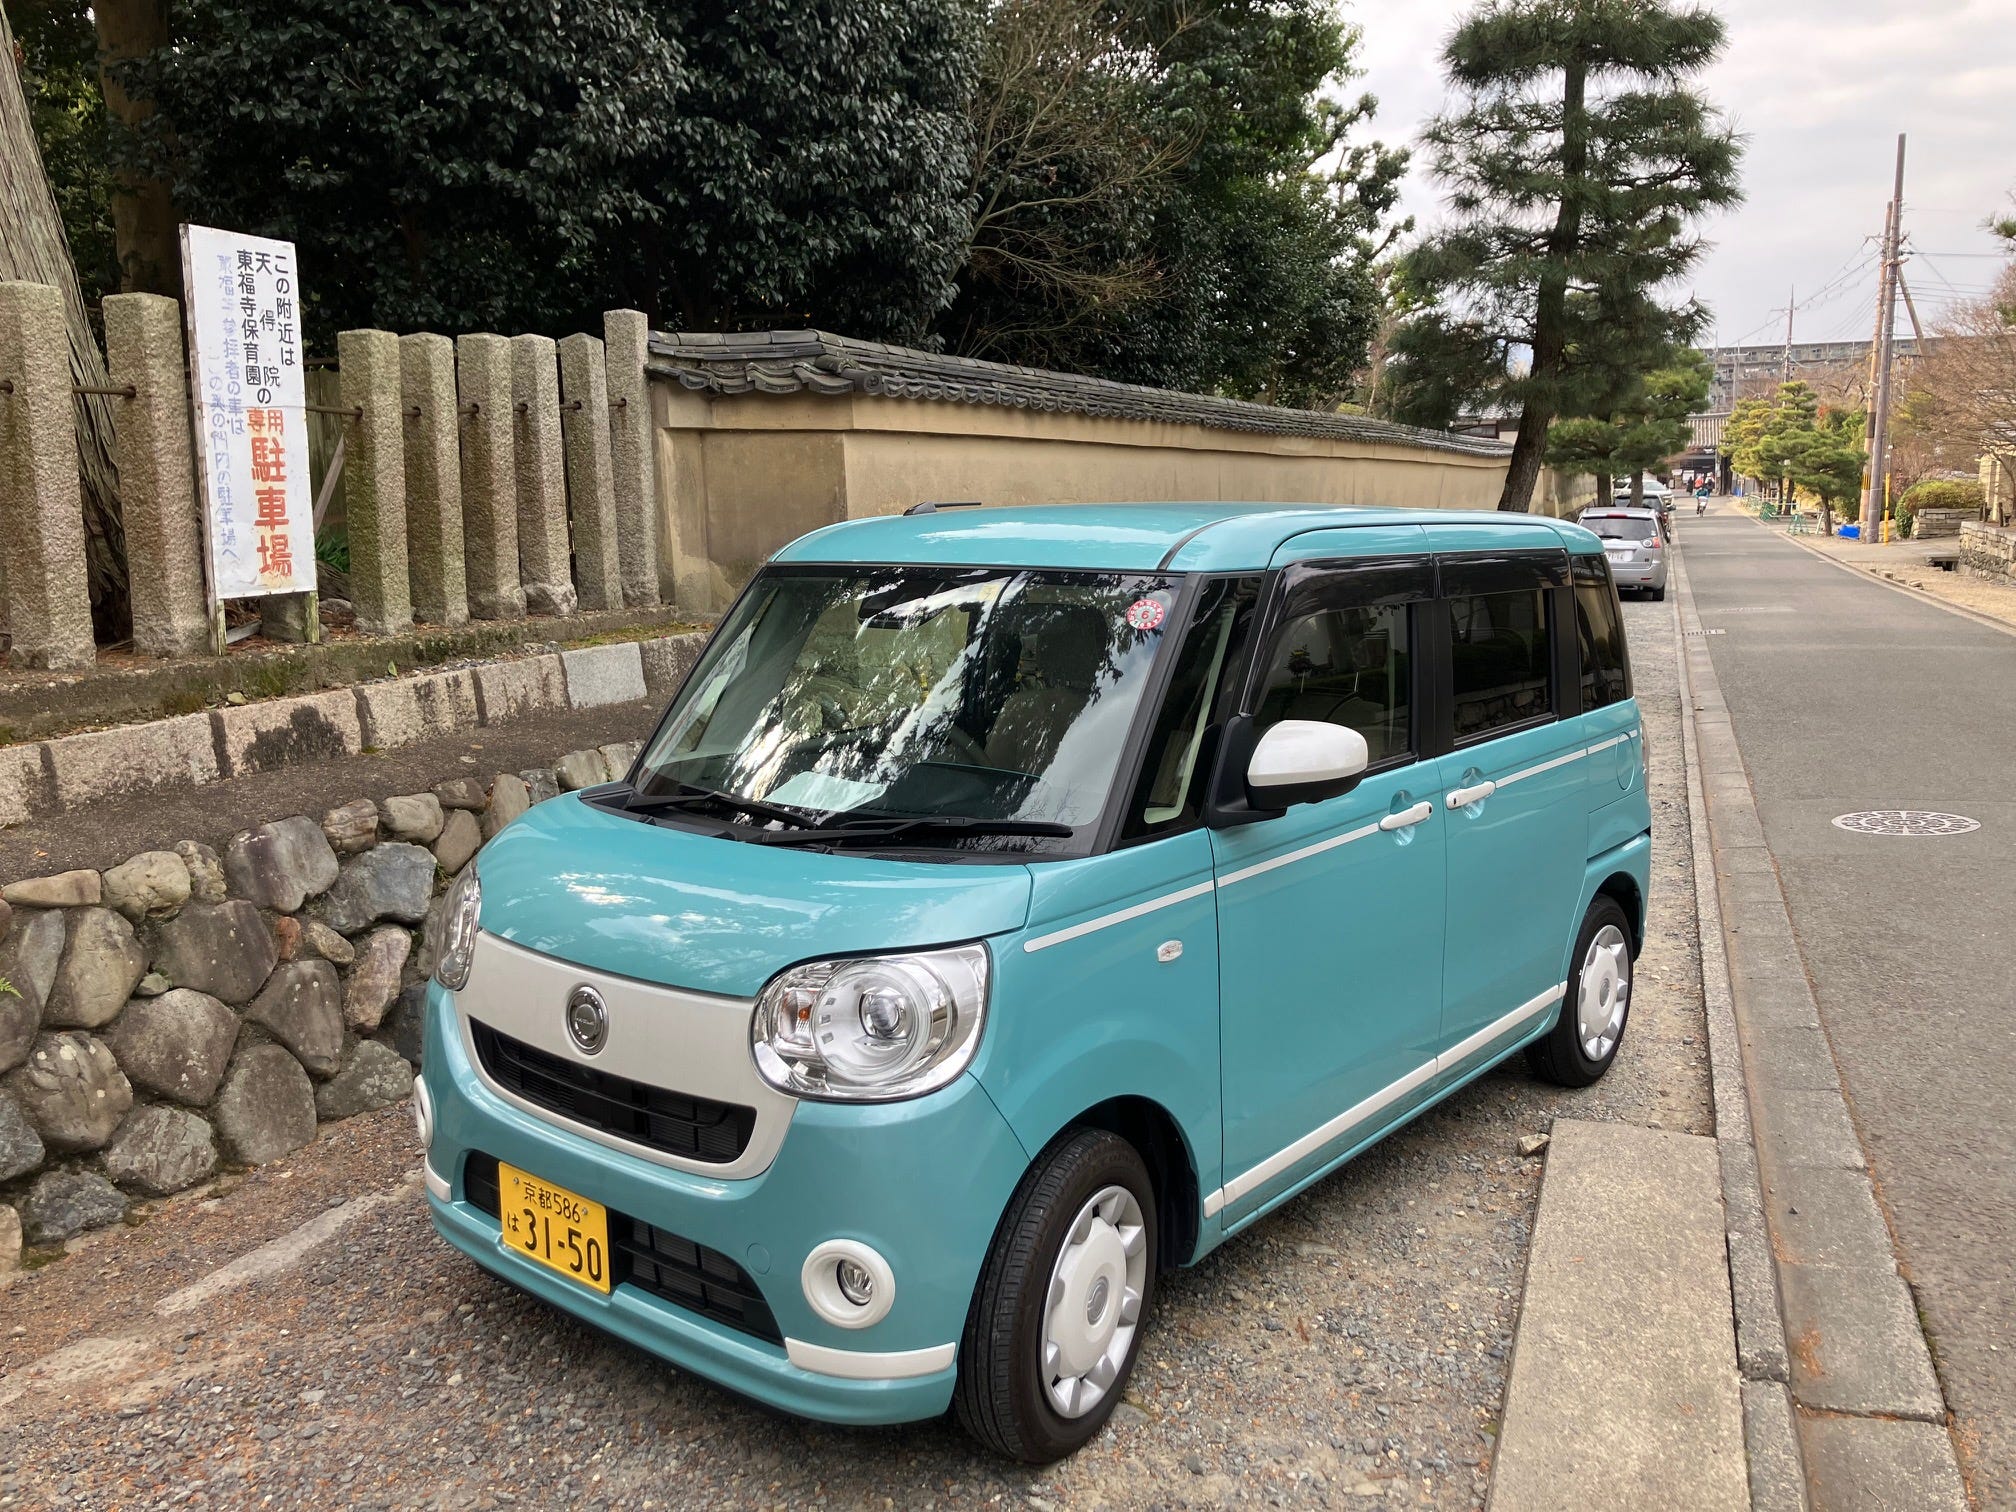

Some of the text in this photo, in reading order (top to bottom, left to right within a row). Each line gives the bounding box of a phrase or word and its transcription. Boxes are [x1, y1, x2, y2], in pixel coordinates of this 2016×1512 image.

[274, 255, 296, 367] この附近は
[507, 1209, 602, 1282] は 31-50
